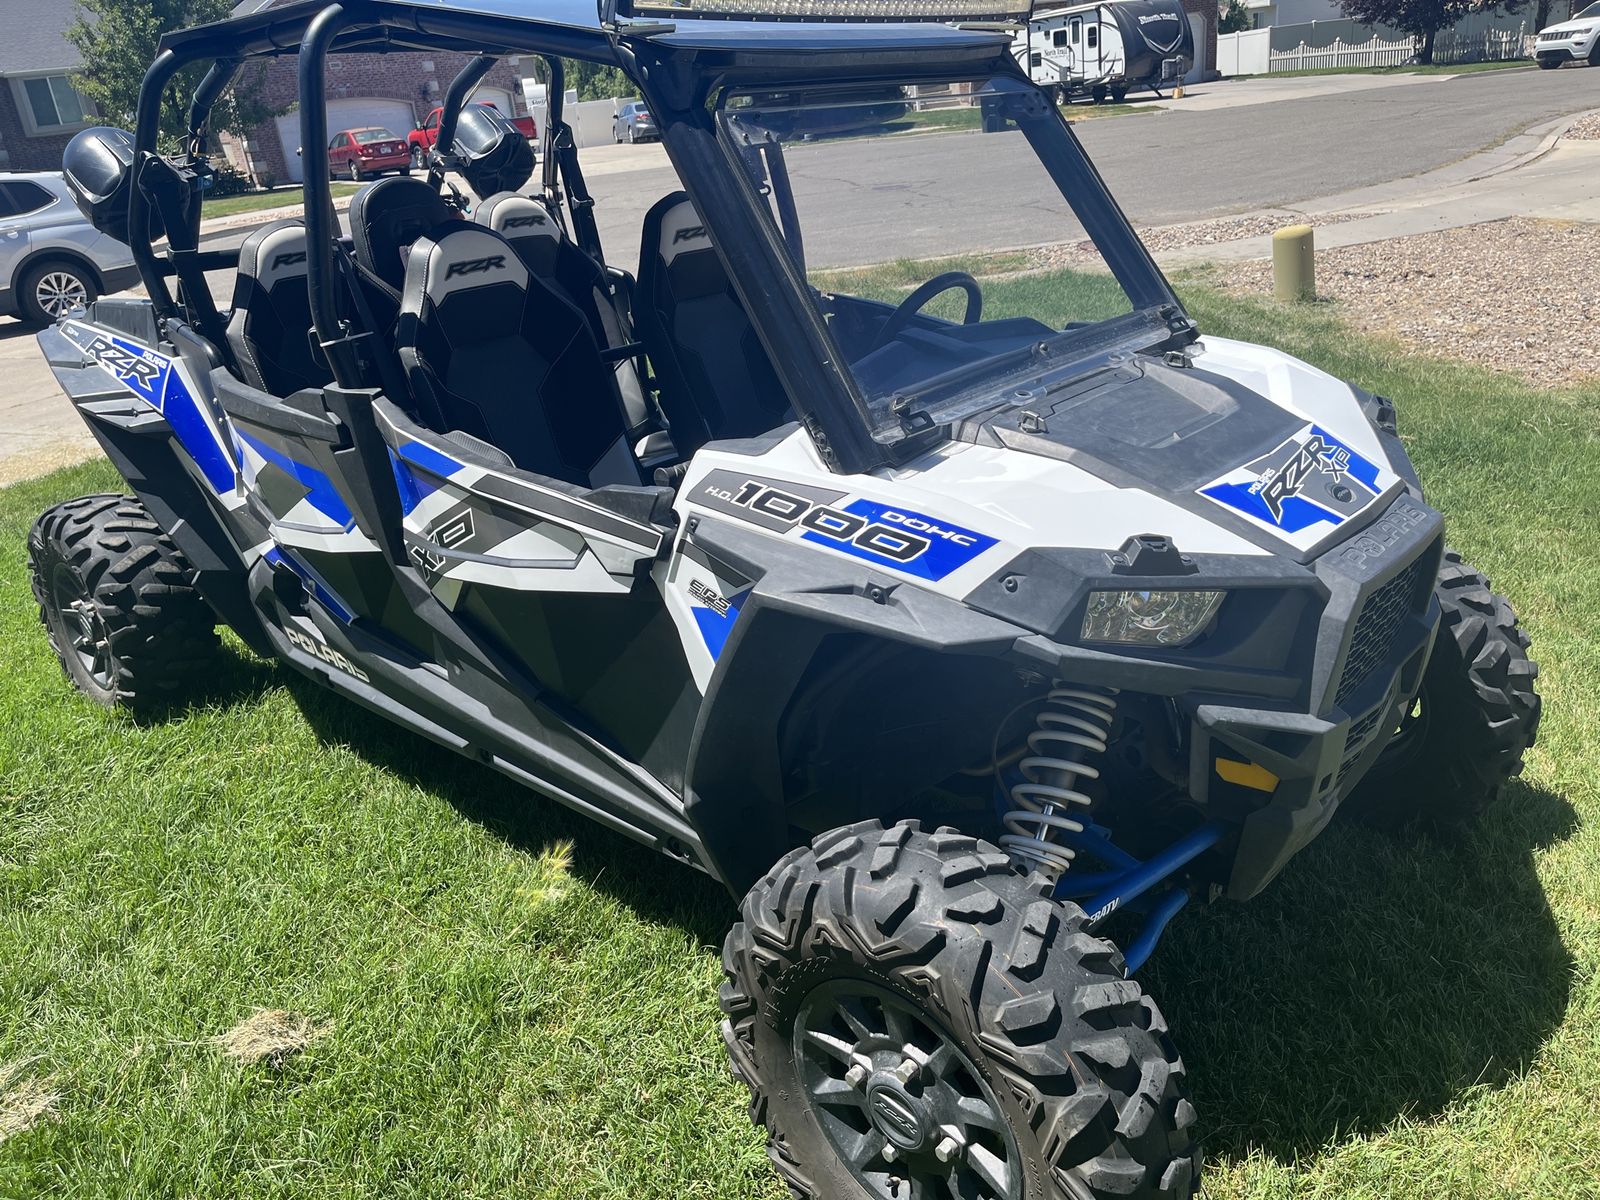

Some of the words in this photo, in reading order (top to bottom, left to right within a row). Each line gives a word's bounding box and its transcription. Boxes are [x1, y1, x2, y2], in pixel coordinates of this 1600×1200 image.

[502, 215, 546, 232] RZR
[271, 250, 307, 271] RZ
[444, 255, 506, 282] RZR
[85, 335, 161, 393] RZR
[142, 350, 168, 370] POLARIS
[1247, 467, 1276, 496] POLARIS
[1260, 434, 1337, 525] RZR
[1321, 447, 1351, 483] XP
[704, 485, 731, 502] H.O.
[730, 479, 932, 564] 1000
[880, 510, 977, 547] DOHC
[1341, 502, 1428, 570] POLARIS
[688, 577, 732, 612] EPS
[284, 626, 370, 683] POLARIS
